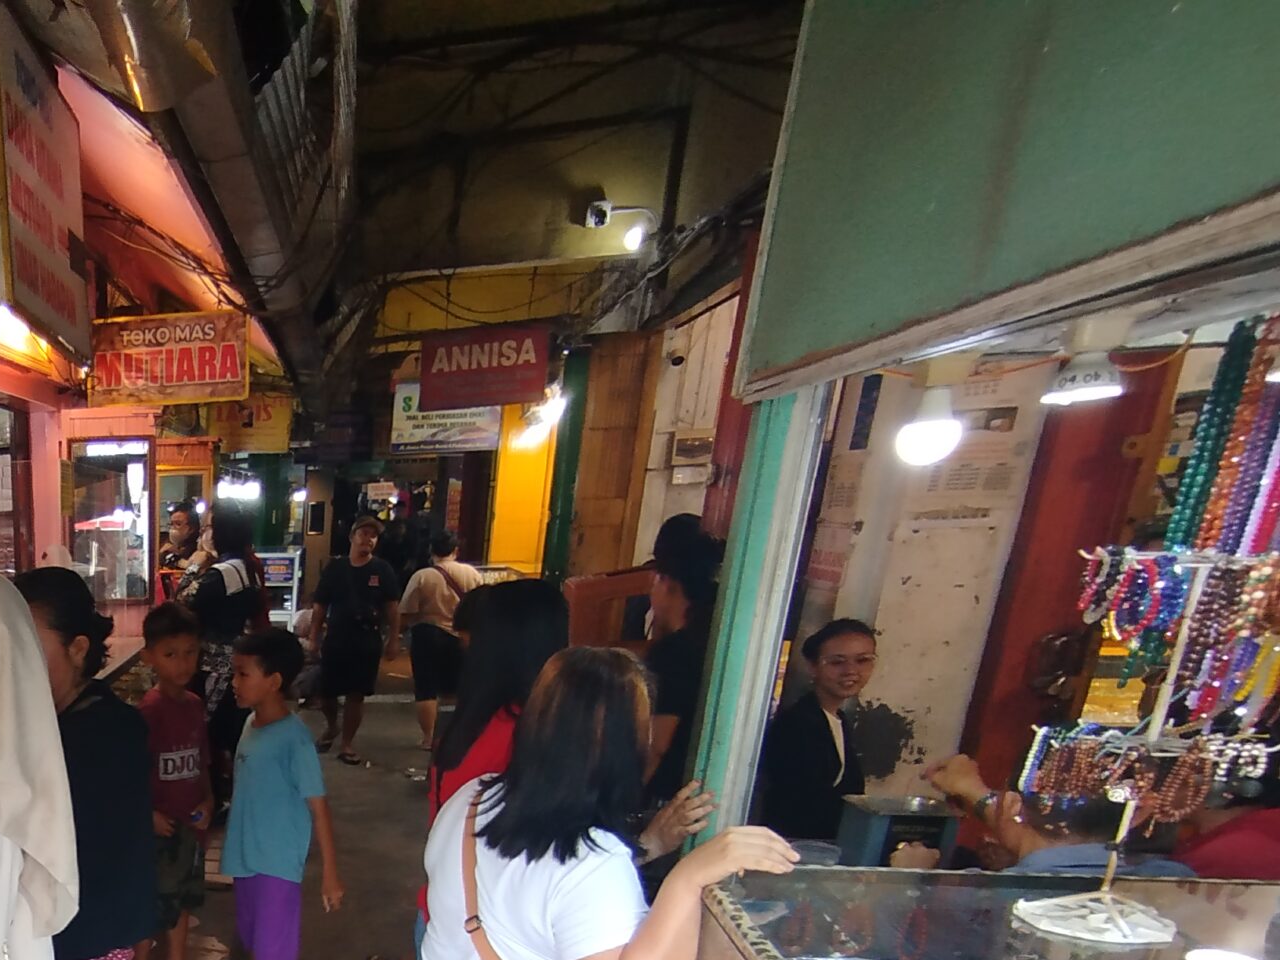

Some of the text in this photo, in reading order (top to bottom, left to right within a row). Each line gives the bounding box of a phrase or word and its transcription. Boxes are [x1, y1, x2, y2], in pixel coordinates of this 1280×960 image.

[120, 323, 216, 346] TOKO MAS
[94, 343, 242, 390] MUTIARA
[431, 338, 537, 374] ANNISA
